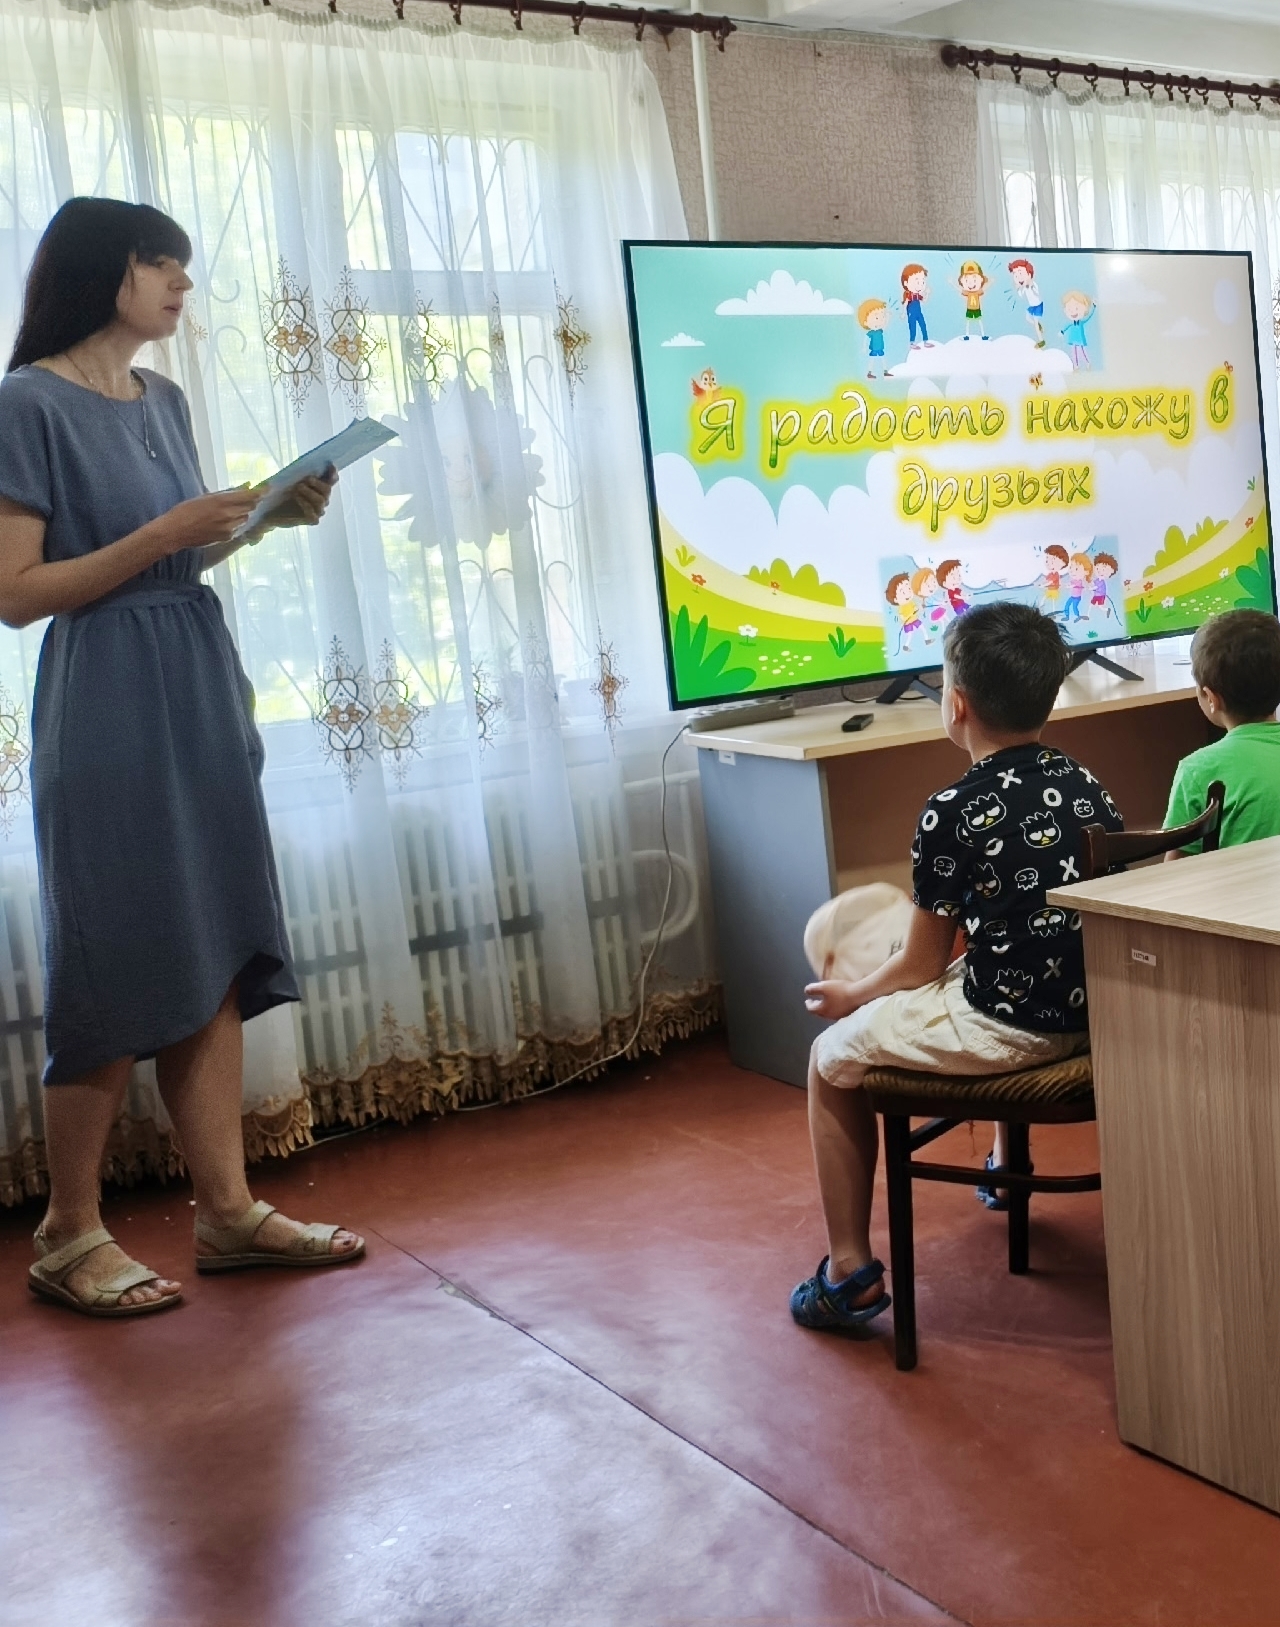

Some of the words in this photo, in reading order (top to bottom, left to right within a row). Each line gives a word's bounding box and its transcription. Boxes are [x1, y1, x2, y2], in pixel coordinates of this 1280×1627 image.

[698, 398, 737, 454] Я
[769, 390, 1005, 468] радость
[1026, 392, 1191, 439] нахожу
[1209, 374, 1229, 423] в
[902, 462, 1091, 532] друзьях
